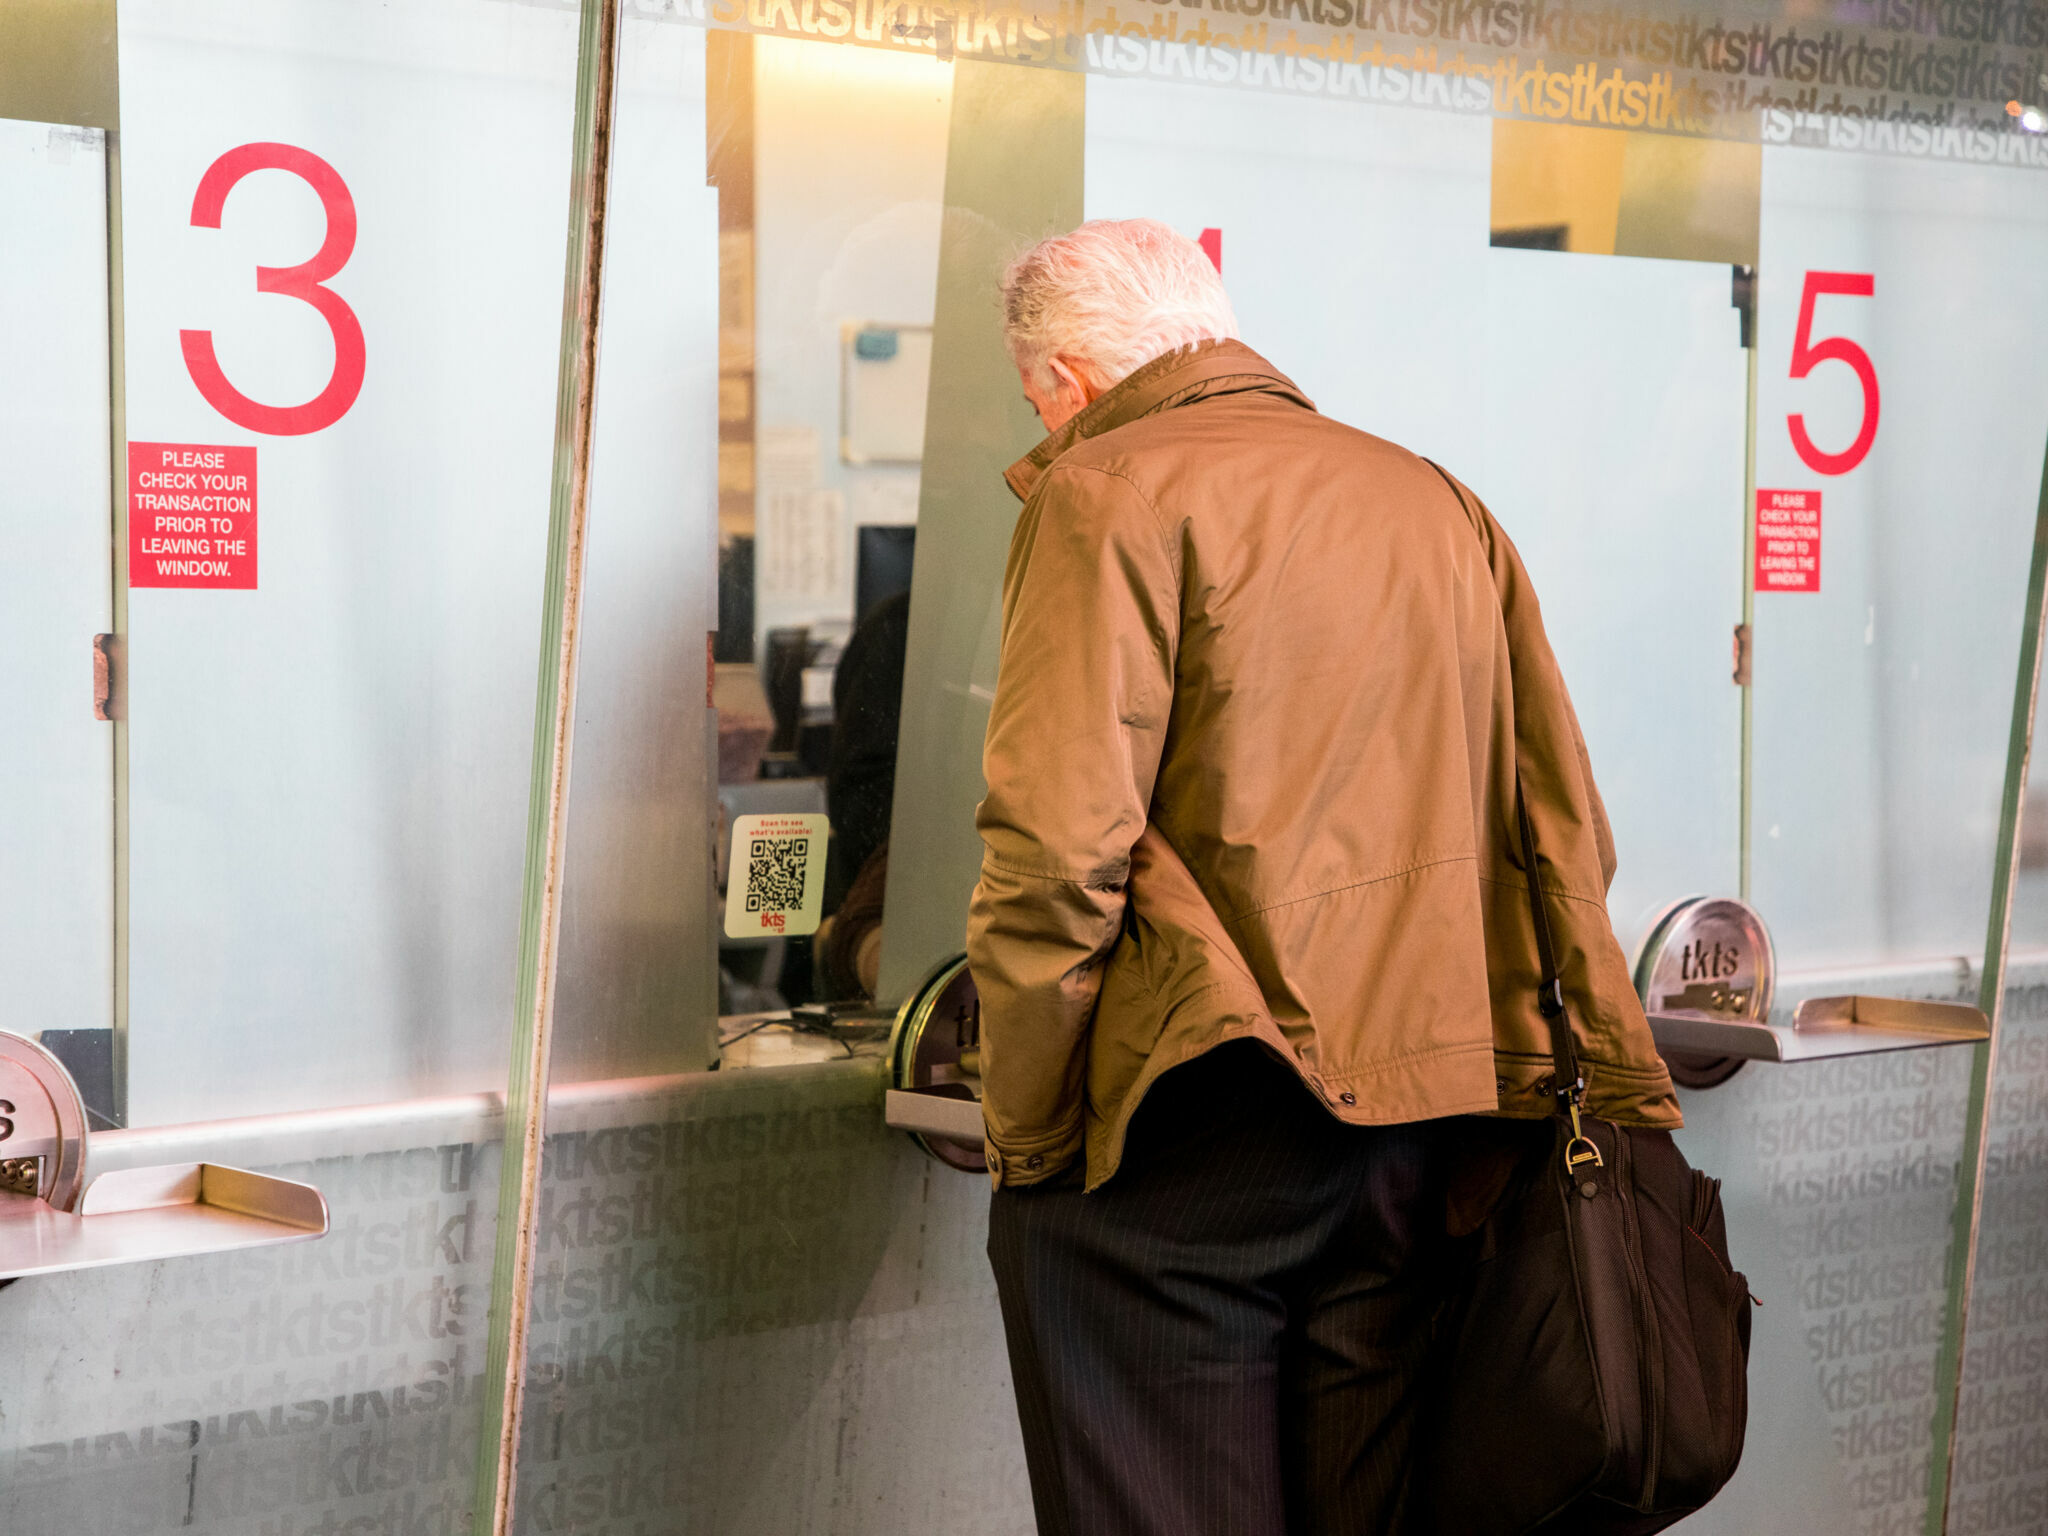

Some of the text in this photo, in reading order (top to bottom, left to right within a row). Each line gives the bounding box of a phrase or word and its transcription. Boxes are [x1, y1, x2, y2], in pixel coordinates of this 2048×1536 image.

[179, 141, 366, 436] 3
[1787, 269, 1880, 476] 5
[162, 451, 225, 468] PLEASE
[139, 472, 247, 491] CHECK YOUR
[135, 494, 251, 512] TRANSACTION
[1772, 494, 1806, 508] PLEASE
[155, 516, 233, 533] PRIOR TO
[1760, 509, 1817, 523] CHECK YOUR
[1759, 524, 1819, 539] TRANSACTION
[141, 538, 246, 555] LEAVING THE
[1796, 541, 1809, 555] TO
[156, 560, 231, 576] WINDOW.
[1760, 556, 1815, 570] LEAVING THE
[760, 912, 785, 927] tkts
[1681, 939, 1740, 981] tkts
